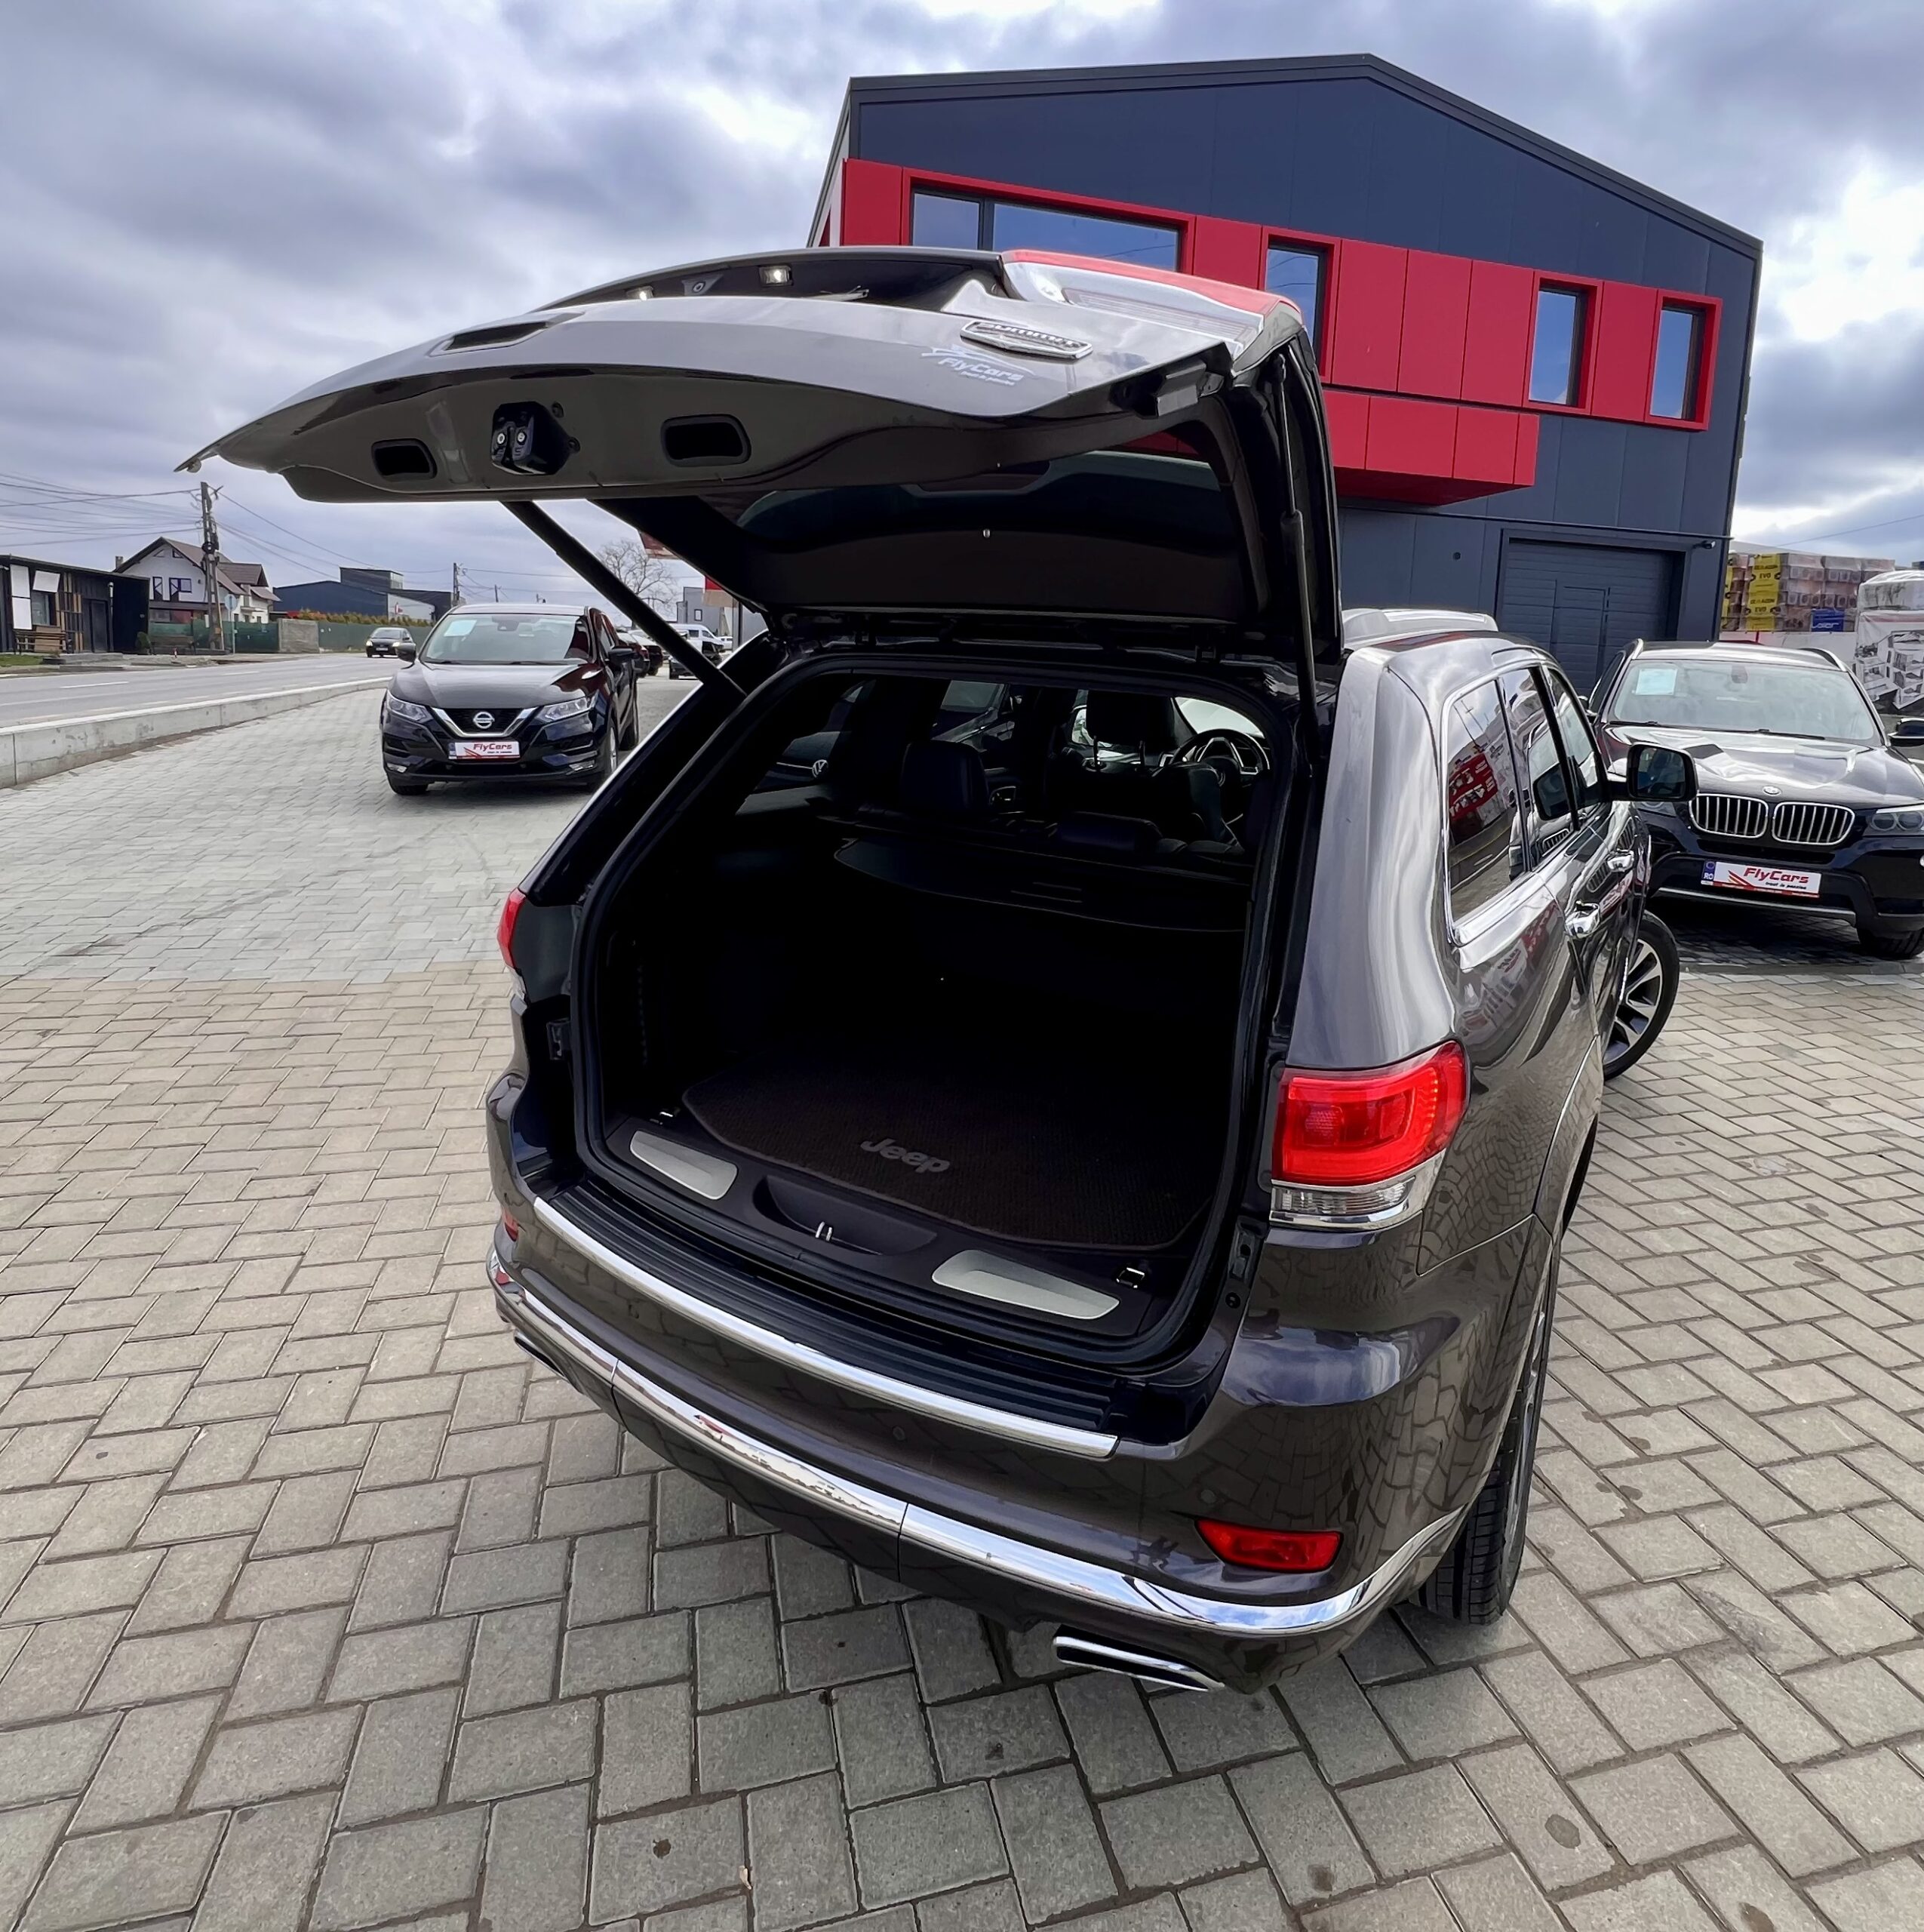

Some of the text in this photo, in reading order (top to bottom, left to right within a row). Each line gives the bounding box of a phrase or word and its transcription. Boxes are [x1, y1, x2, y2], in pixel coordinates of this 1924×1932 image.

[937, 357, 1025, 381] FlyCars
[473, 743, 512, 751] FlyCars
[1703, 872, 1714, 880] RO
[1743, 867, 1809, 884] FlyCars
[859, 1137, 951, 1174] Jeep
